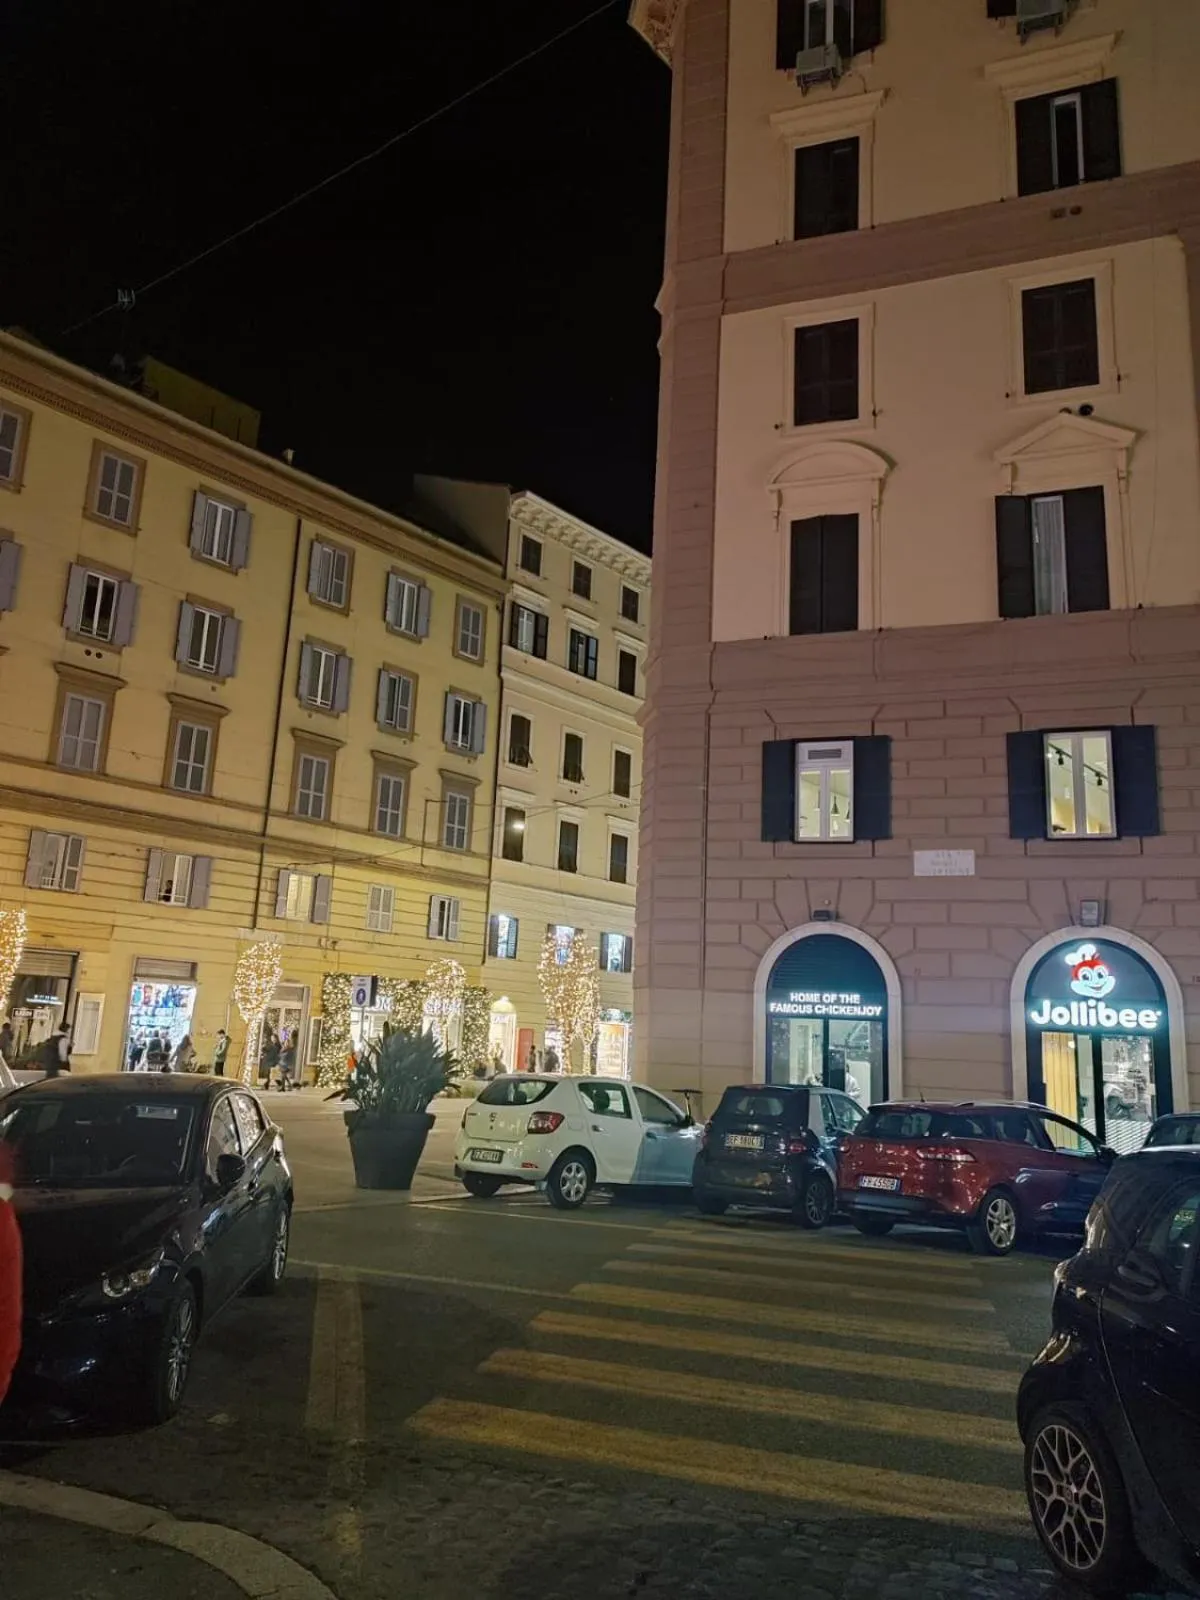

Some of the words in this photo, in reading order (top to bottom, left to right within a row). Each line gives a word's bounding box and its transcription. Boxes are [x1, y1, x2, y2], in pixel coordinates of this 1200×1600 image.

[790, 992, 820, 1002] HOME
[822, 993, 837, 1003] OF
[838, 994, 861, 1004] THE
[770, 1003, 813, 1014] FAMOUS
[814, 1004, 882, 1016] CHICKENJOY
[1030, 999, 1159, 1029] Jollibee
